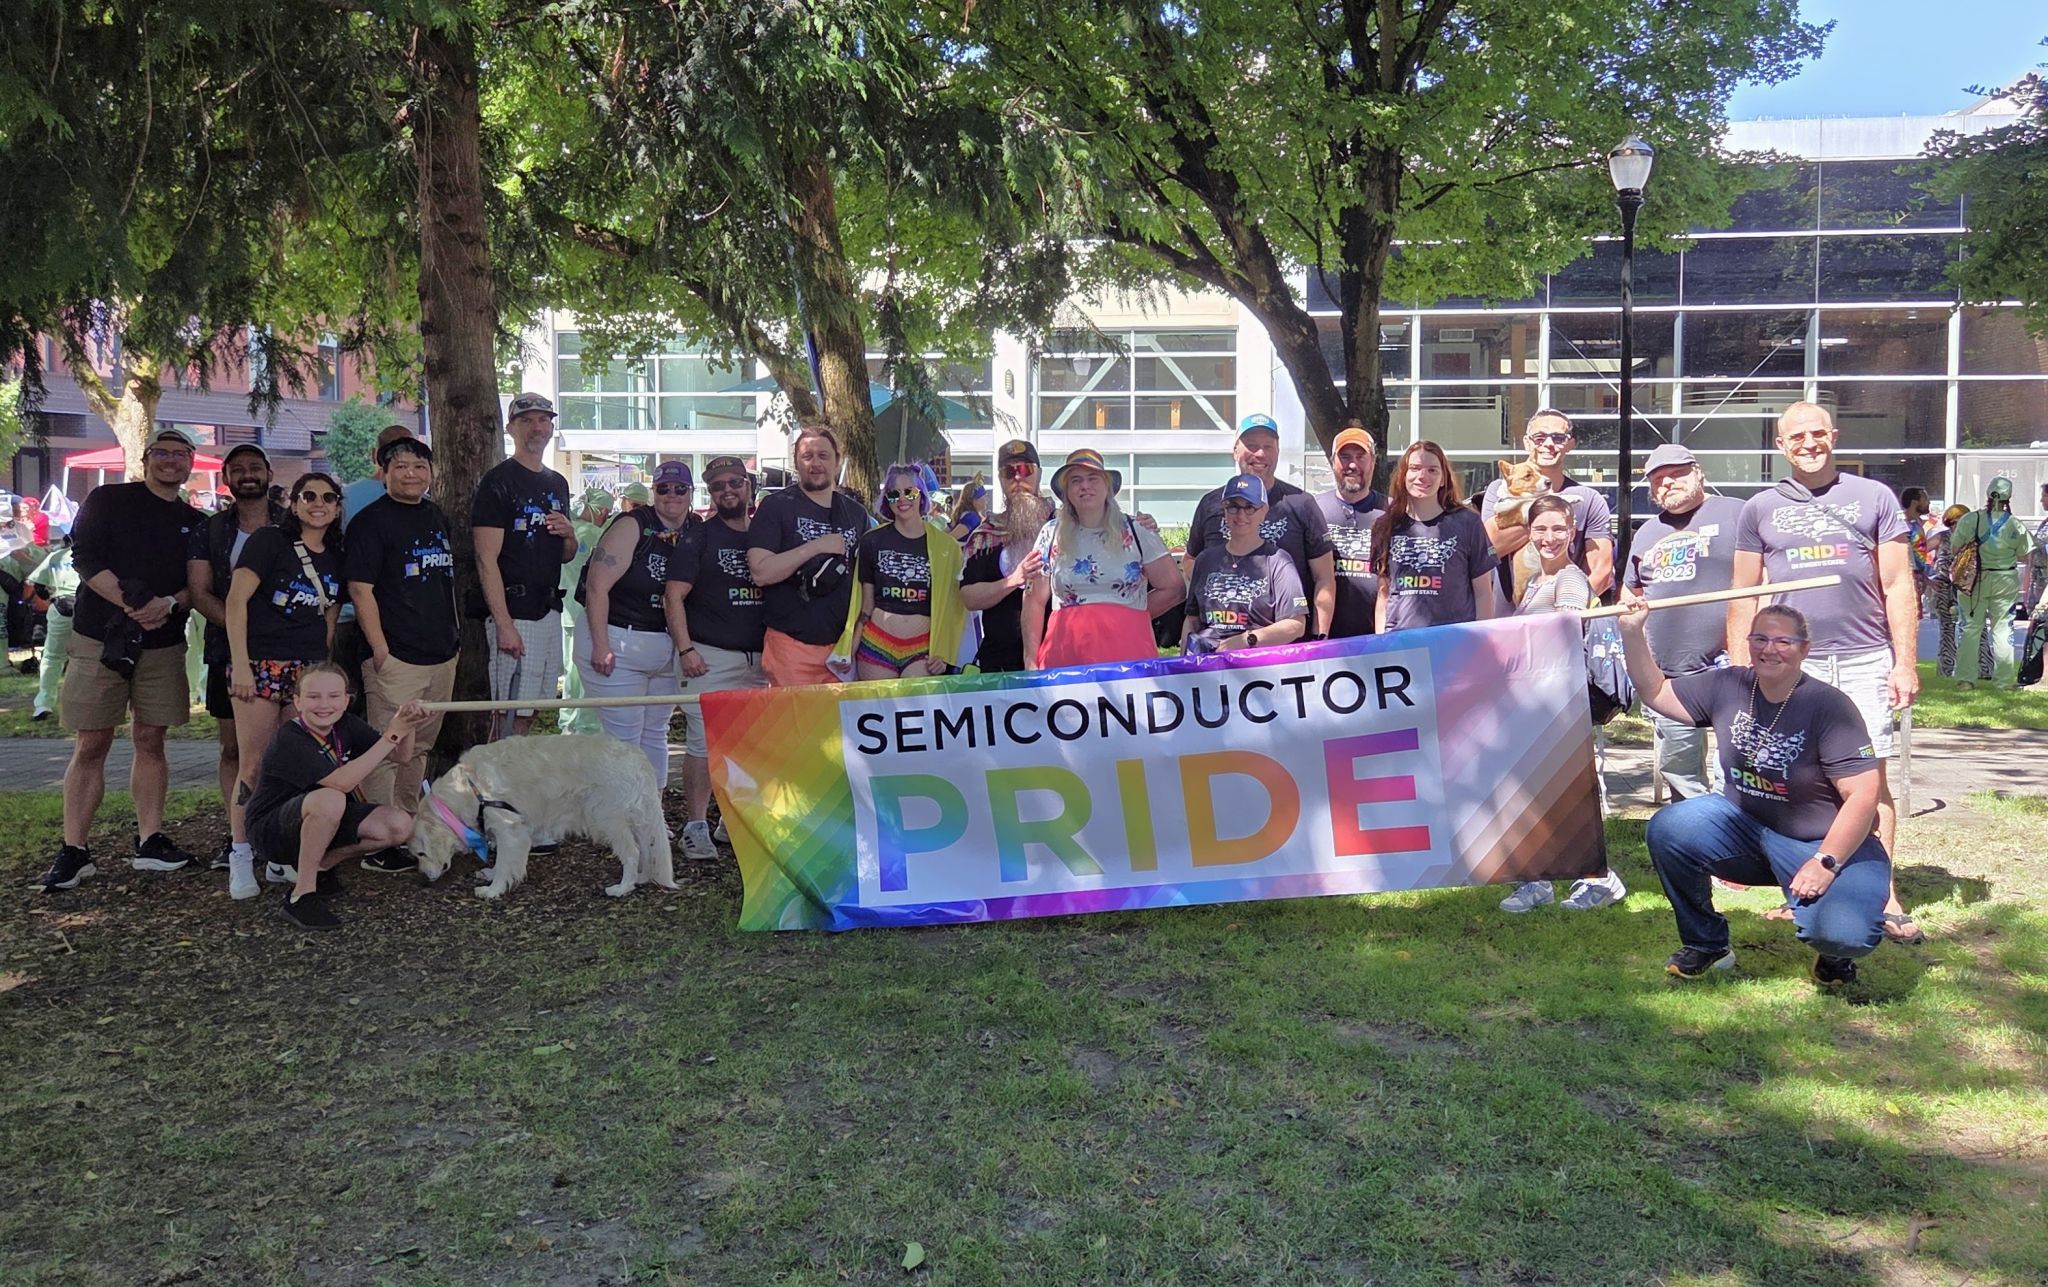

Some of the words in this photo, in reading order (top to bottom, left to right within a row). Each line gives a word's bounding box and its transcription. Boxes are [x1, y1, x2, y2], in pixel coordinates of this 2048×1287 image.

[1652, 546, 1695, 567] Pride
[1785, 543, 1849, 562] PRIDE
[1653, 563, 1695, 580] 2023
[1396, 575, 1442, 589] PRIDE
[728, 587, 762, 600] PRID
[882, 587, 927, 601] PRIDE
[1205, 610, 1248, 625] PRIDE
[857, 664, 1416, 755] SEMICONDUCTOR
[1730, 767, 1789, 795] PRIDE
[869, 728, 1431, 892] PRIDE
